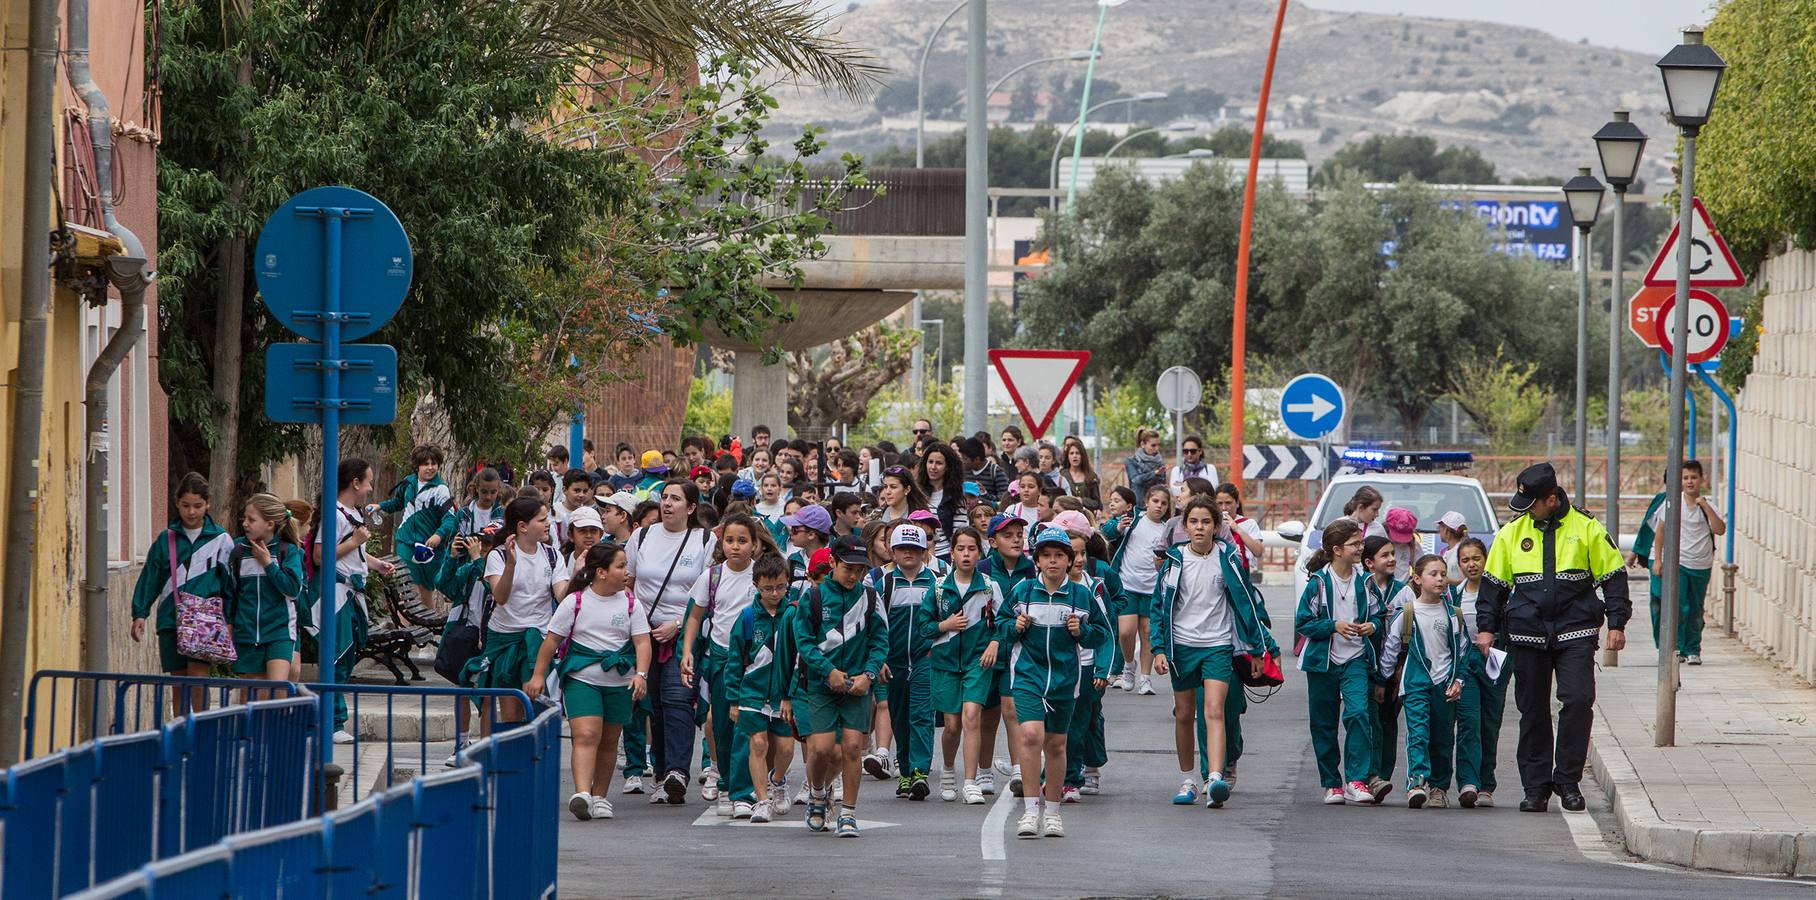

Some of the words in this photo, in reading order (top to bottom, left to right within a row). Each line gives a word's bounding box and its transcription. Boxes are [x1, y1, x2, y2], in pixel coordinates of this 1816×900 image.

[1538, 243, 1567, 259] FAZ
[1636, 307, 1661, 322] ST
[901, 528, 920, 537] USA
